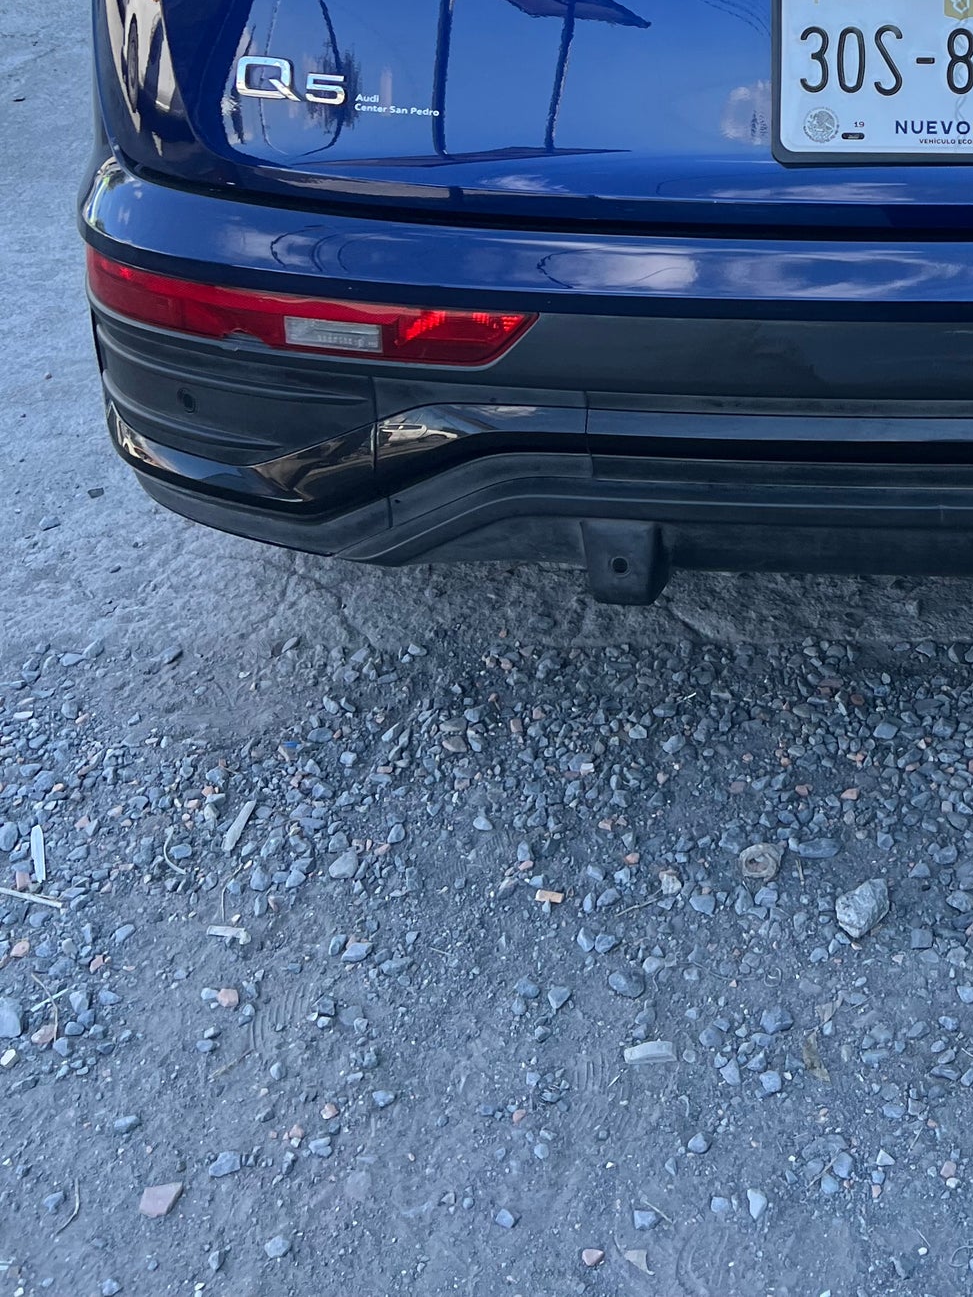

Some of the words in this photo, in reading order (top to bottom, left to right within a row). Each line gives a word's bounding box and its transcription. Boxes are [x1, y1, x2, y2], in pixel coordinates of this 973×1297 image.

[236, 55, 346, 105] Q5
[355, 93, 380, 103] Audi
[354, 103, 387, 114] Center
[389, 103, 408, 115] San
[410, 104, 441, 117] Pedro
